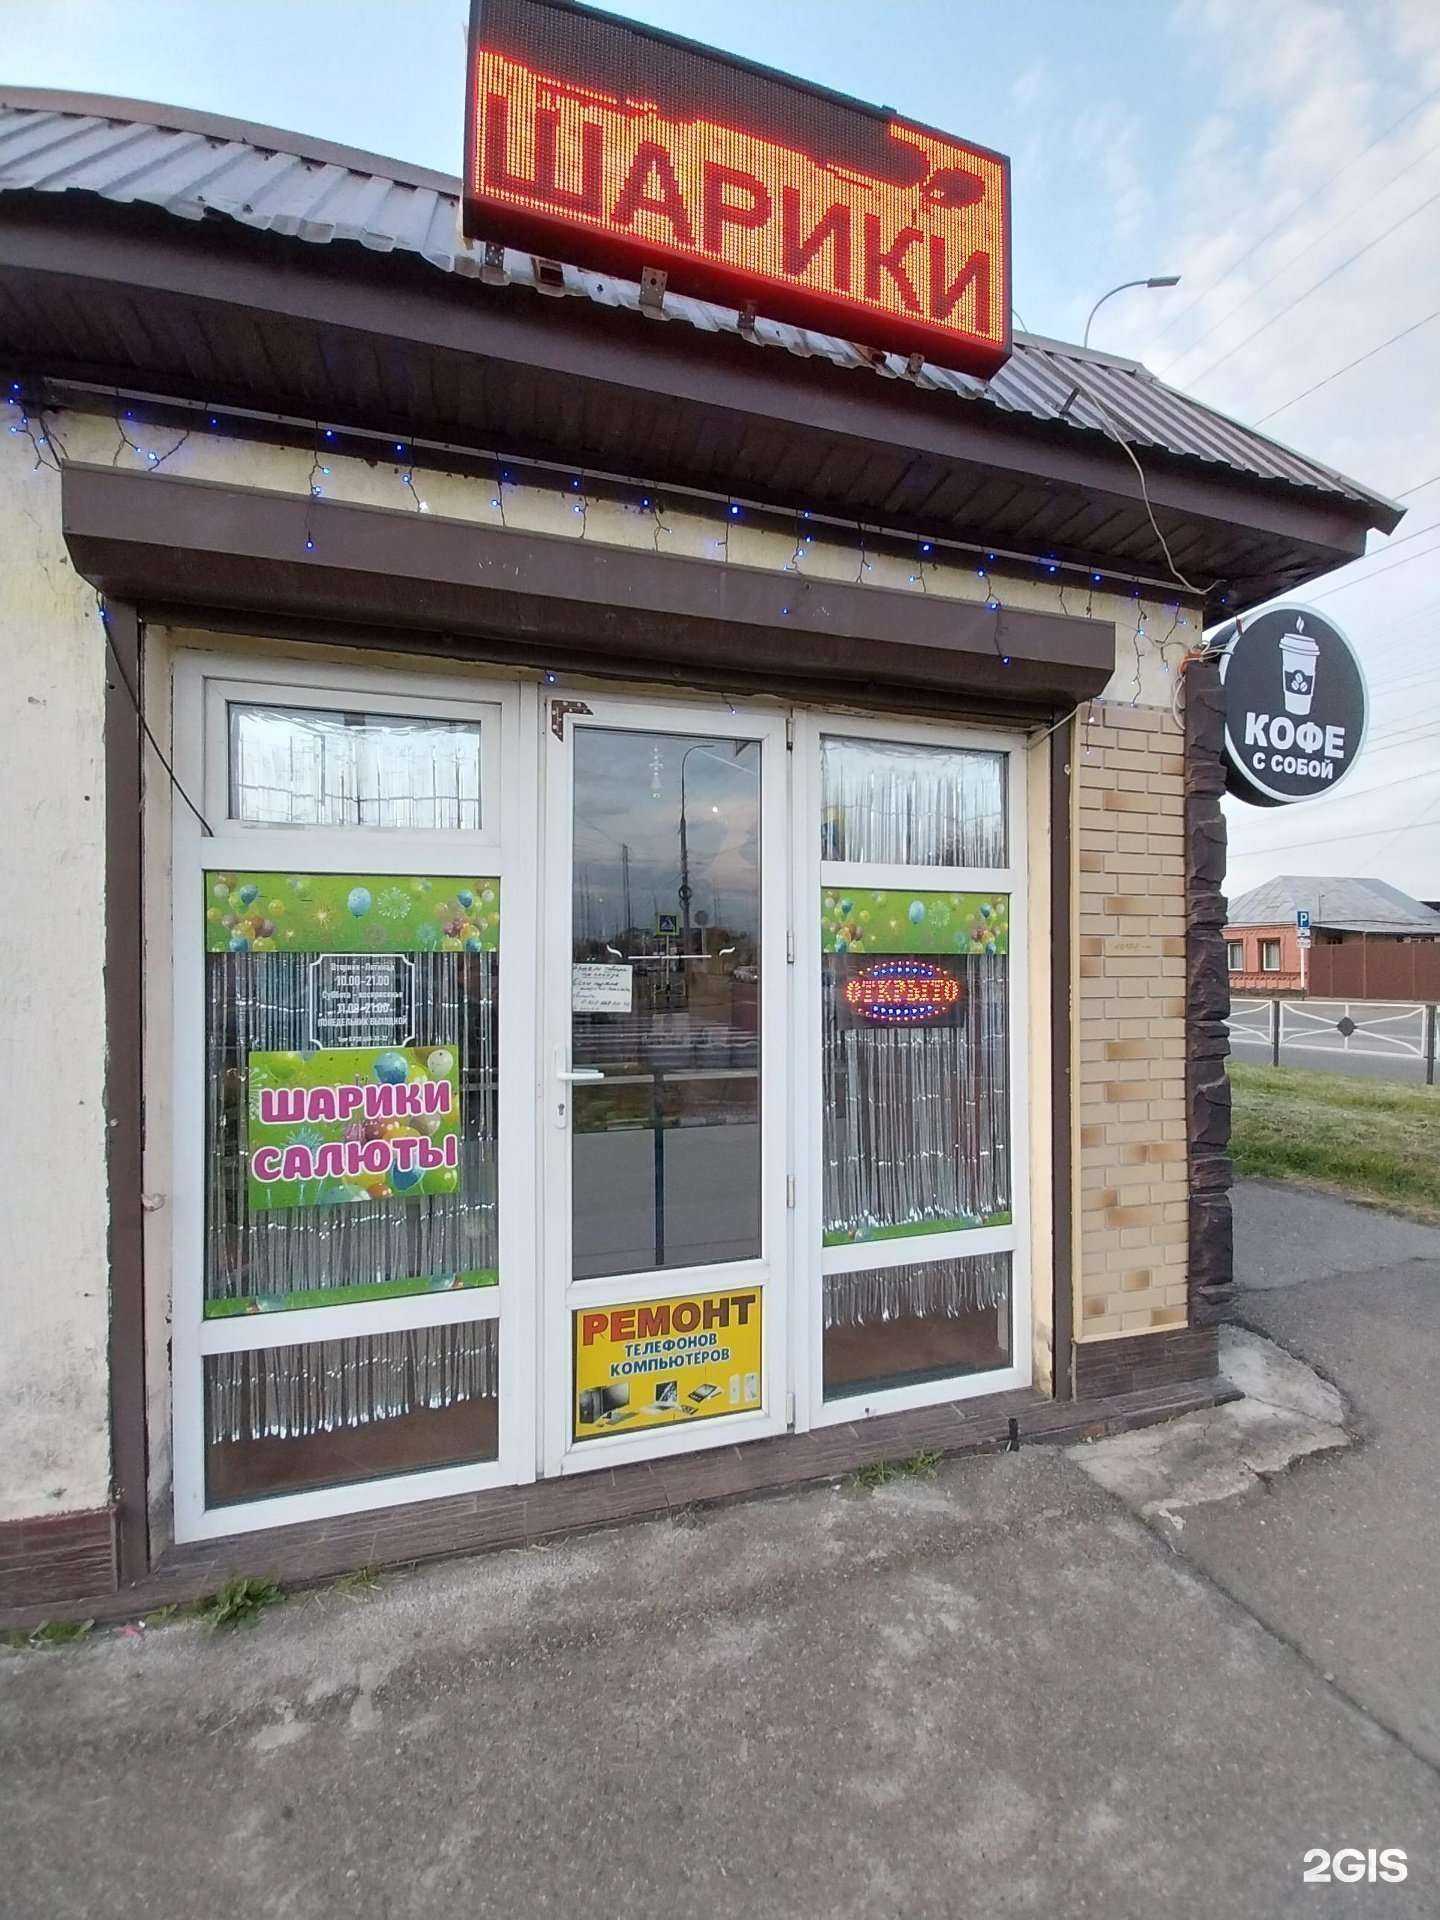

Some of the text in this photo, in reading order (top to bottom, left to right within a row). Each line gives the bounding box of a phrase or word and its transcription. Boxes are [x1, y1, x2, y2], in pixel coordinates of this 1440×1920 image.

[482, 91, 990, 336] ШАРИКИ
[1245, 711, 1346, 759] КОФЕ
[1252, 752, 1334, 780] С СОБОЙ
[1300, 912, 1308, 927] P
[846, 978, 960, 1003] ОТКРЫТО
[260, 1080, 452, 1124] ШАРИКИ
[252, 1135, 458, 1181] САЛЮТЫ
[582, 1294, 756, 1346] РЕМОНТ
[610, 1348, 731, 1377] КОМПЬЮТЕРОВ
[625, 1332, 718, 1358] ТЕЛЕФОНОВ
